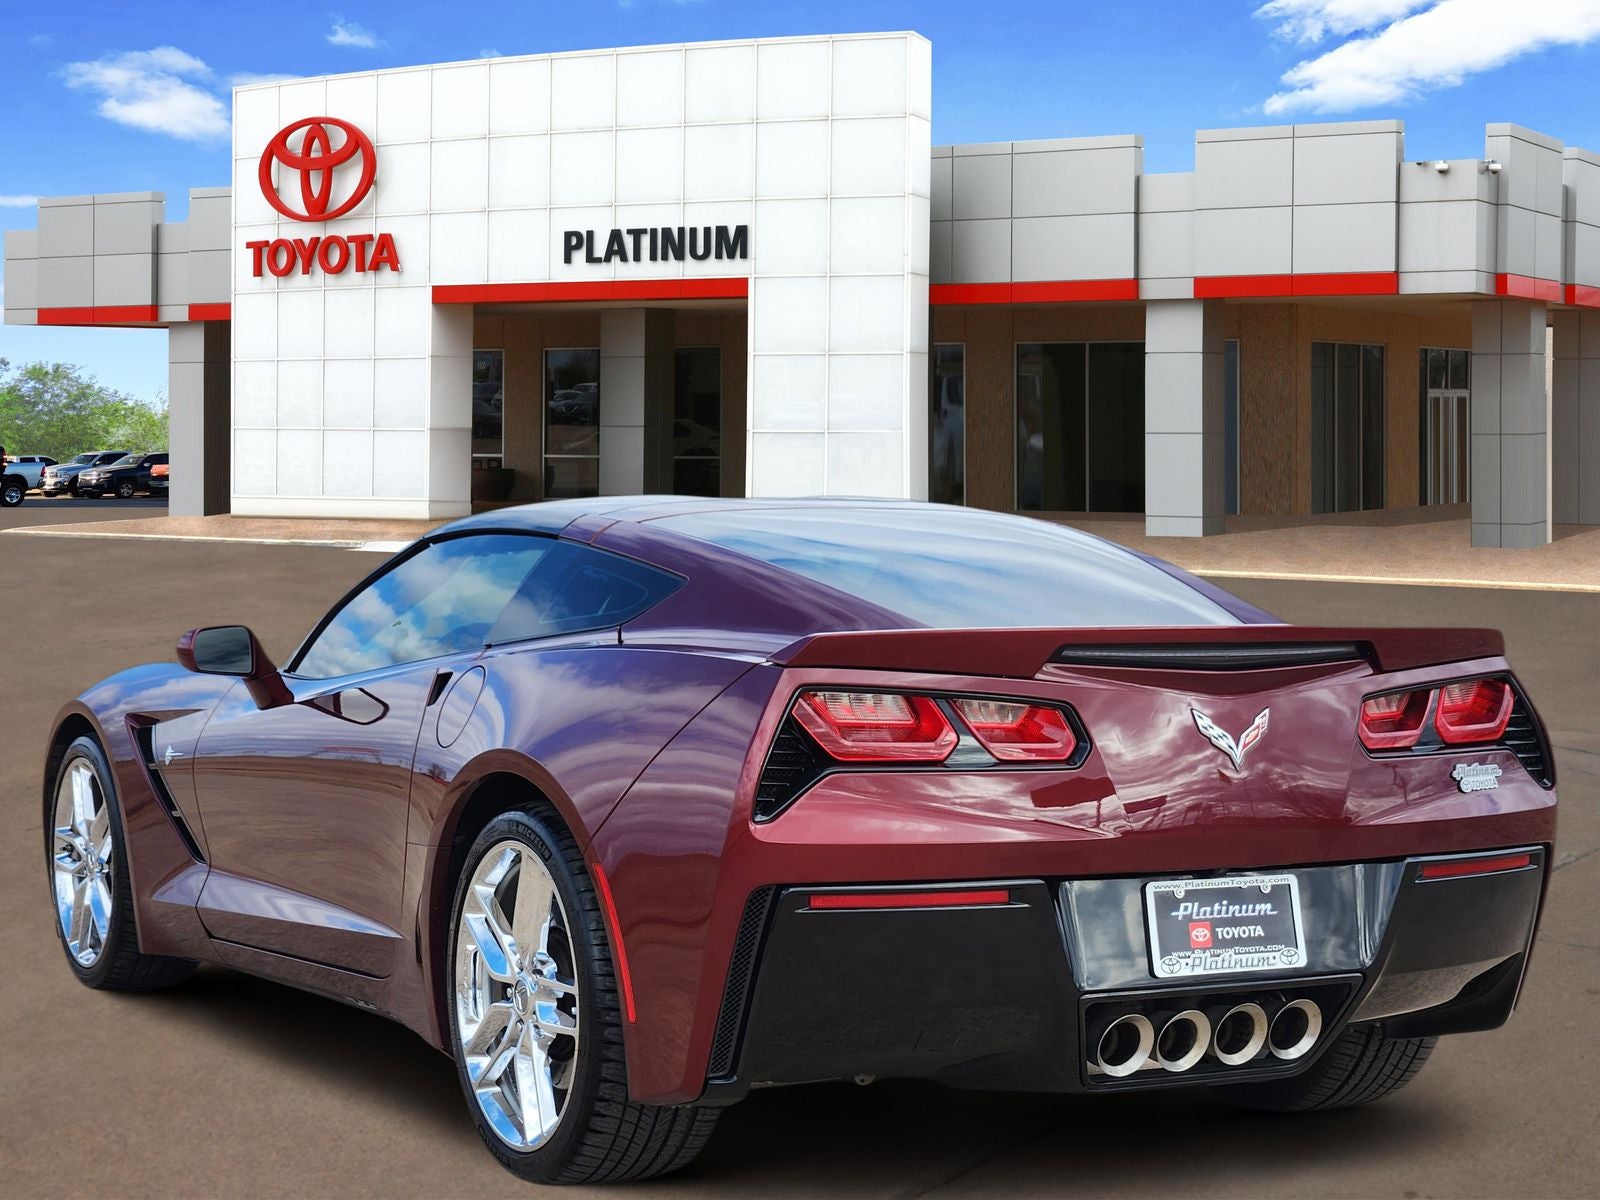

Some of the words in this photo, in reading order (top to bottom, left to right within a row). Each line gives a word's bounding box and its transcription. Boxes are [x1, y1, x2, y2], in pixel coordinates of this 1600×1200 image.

[563, 225, 749, 264] PLATINUM
[245, 232, 403, 279] TOYOTA
[518, 825, 551, 860] MICHELIN
[1153, 876, 1290, 890] www.PlatinumToyota.com
[1170, 900, 1278, 920] Platinum
[1215, 926, 1265, 939] TOYOTA
[1190, 953, 1277, 972] Platinum
